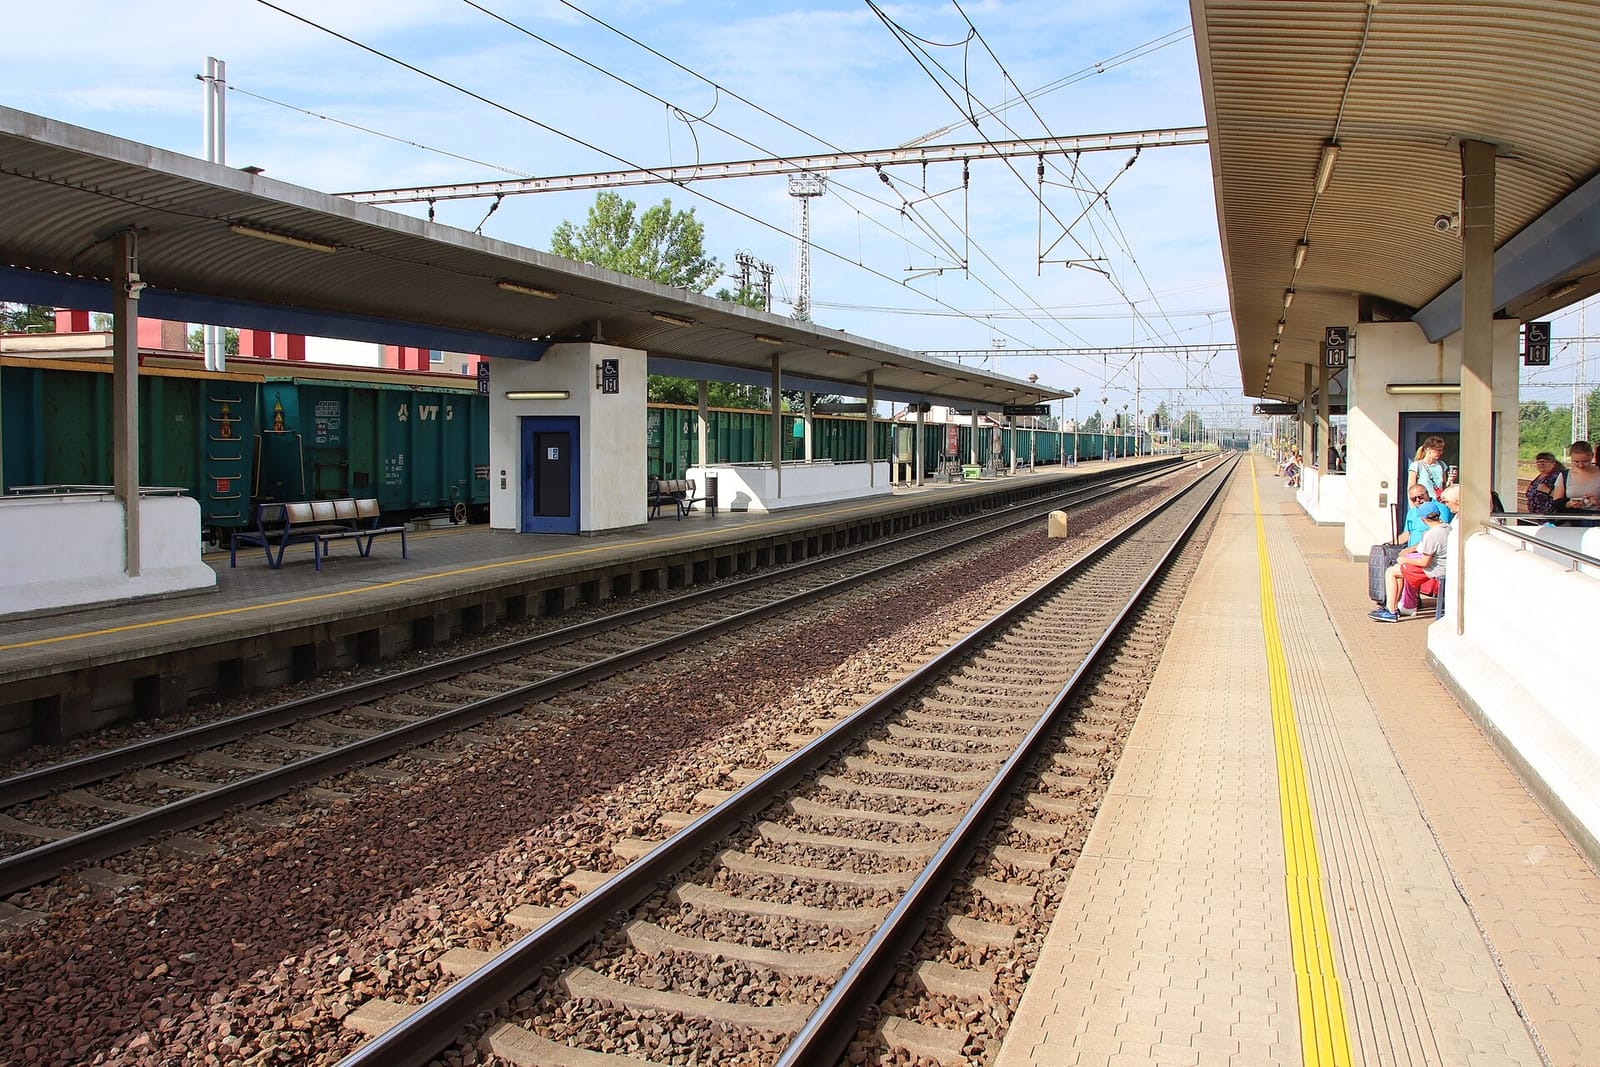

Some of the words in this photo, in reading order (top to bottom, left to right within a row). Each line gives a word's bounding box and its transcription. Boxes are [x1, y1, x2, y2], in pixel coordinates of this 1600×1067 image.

[418, 405, 454, 421] VTG
[950, 407, 955, 415] 3
[1255, 405, 1261, 414] 2
